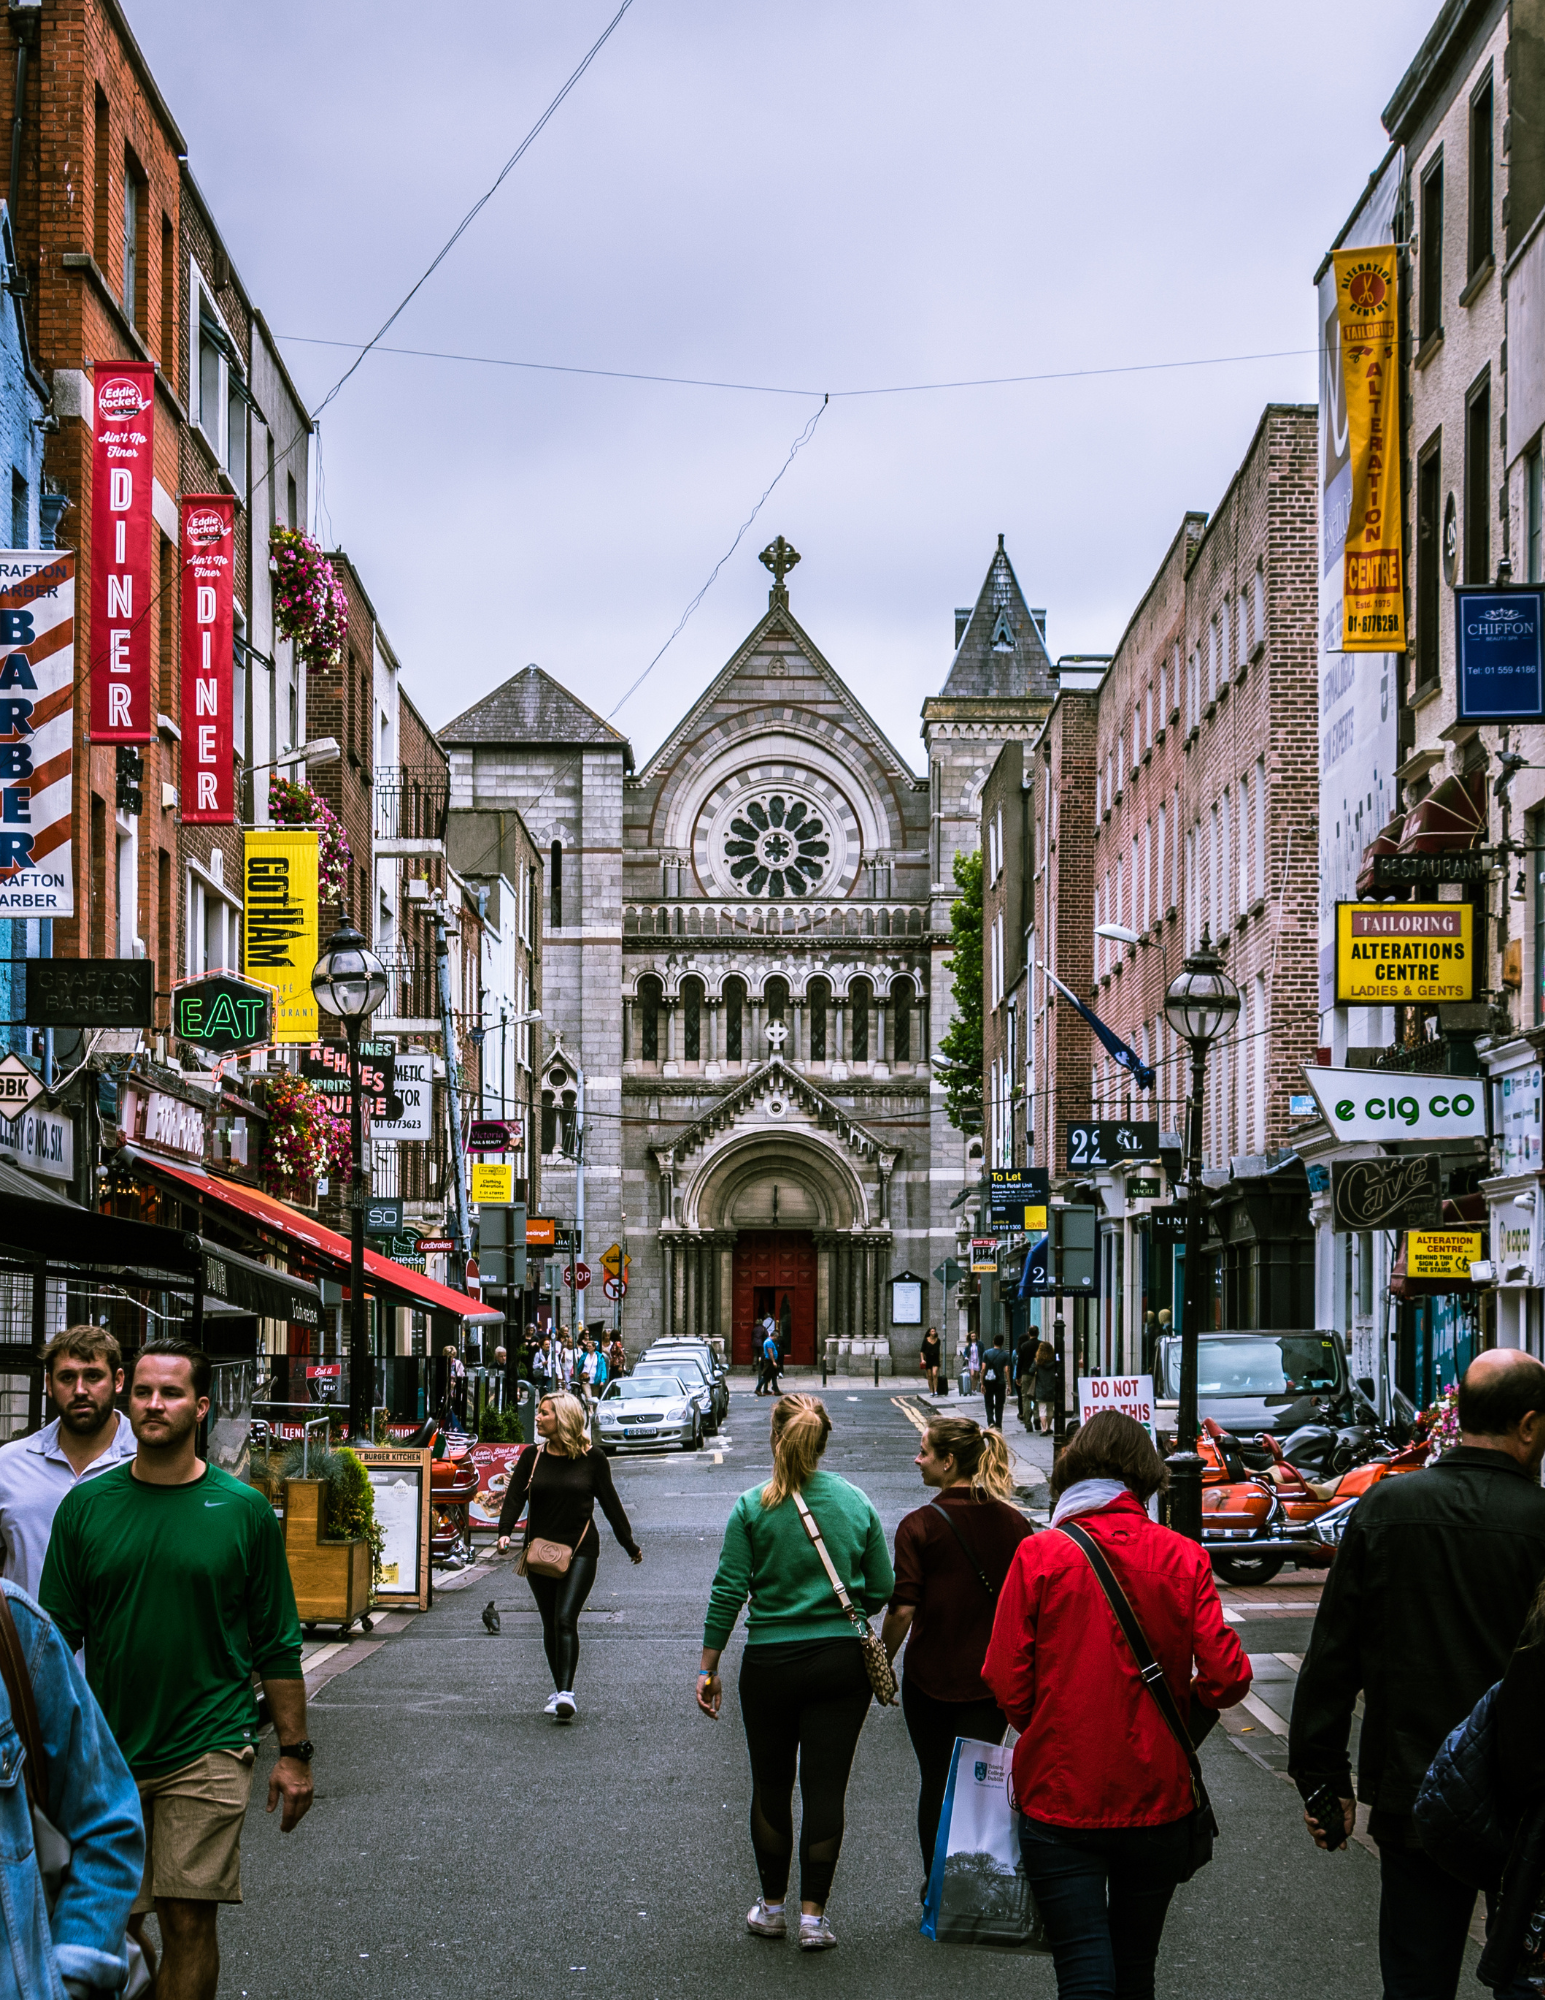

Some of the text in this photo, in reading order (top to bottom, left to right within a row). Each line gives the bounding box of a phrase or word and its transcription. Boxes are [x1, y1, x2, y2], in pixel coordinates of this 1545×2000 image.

[1341, 263, 1392, 290] ALTERATION
[1349, 299, 1389, 317] CENTRE
[105, 386, 135, 398] Eddie
[99, 394, 142, 408] Rocket's
[98, 431, 147, 445] Ain't No
[107, 445, 138, 457] Finer
[1365, 361, 1382, 543] ALTERATION
[192, 516, 218, 527] Eddie
[186, 554, 228, 566] Ain't No
[0, 564, 67, 579] RAFTON
[194, 567, 221, 577] Finer
[1349, 555, 1398, 589] CENTRE
[0, 584, 58, 599] ARBER
[107, 468, 132, 727] DINER
[1356, 599, 1391, 609] Estd. 1975
[1348, 615, 1399, 633] 01-6776258
[1467, 622, 1534, 635] CHIFFON
[1467, 665, 1536, 675] Tel: 01 559 4186
[195, 586, 218, 810] DINER
[0, 609, 38, 868] BARBER
[0, 873, 64, 888] RAFTON
[0, 894, 57, 907] ARBER
[248, 857, 310, 967] GOTHAM
[1360, 916, 1454, 932] TAILORING
[1351, 942, 1465, 960] ALTERATIONS
[1375, 964, 1439, 980] CENTRE
[39, 971, 141, 989] GRAFTON
[1351, 985, 1464, 997] LADIES & GENTS
[181, 993, 264, 1039] EAT
[281, 1008, 314, 1017] URANT
[358, 1042, 392, 1057] INES
[393, 1064, 426, 1082] METIC
[1335, 1100, 1355, 1121] e
[1429, 1094, 1475, 1118] co
[374, 1119, 421, 1129] 01 6773623
[0, 1114, 26, 1151] LLERY
[35, 1119, 49, 1159] NO.
[51, 1124, 63, 1162] SIX
[471, 1131, 504, 1139] Victoria
[991, 1172, 1021, 1181] To Let
[369, 1210, 397, 1223] SO
[1026, 1220, 1045, 1228] savills
[1417, 1236, 1473, 1244] ALTERATION
[1427, 1245, 1463, 1253] CENTRE
[565, 1271, 590, 1281] SOP
[1092, 1380, 1138, 1398] DO NOT
[1121, 1403, 1150, 1421] THIS
[392, 1453, 421, 1461] KITCHEN
